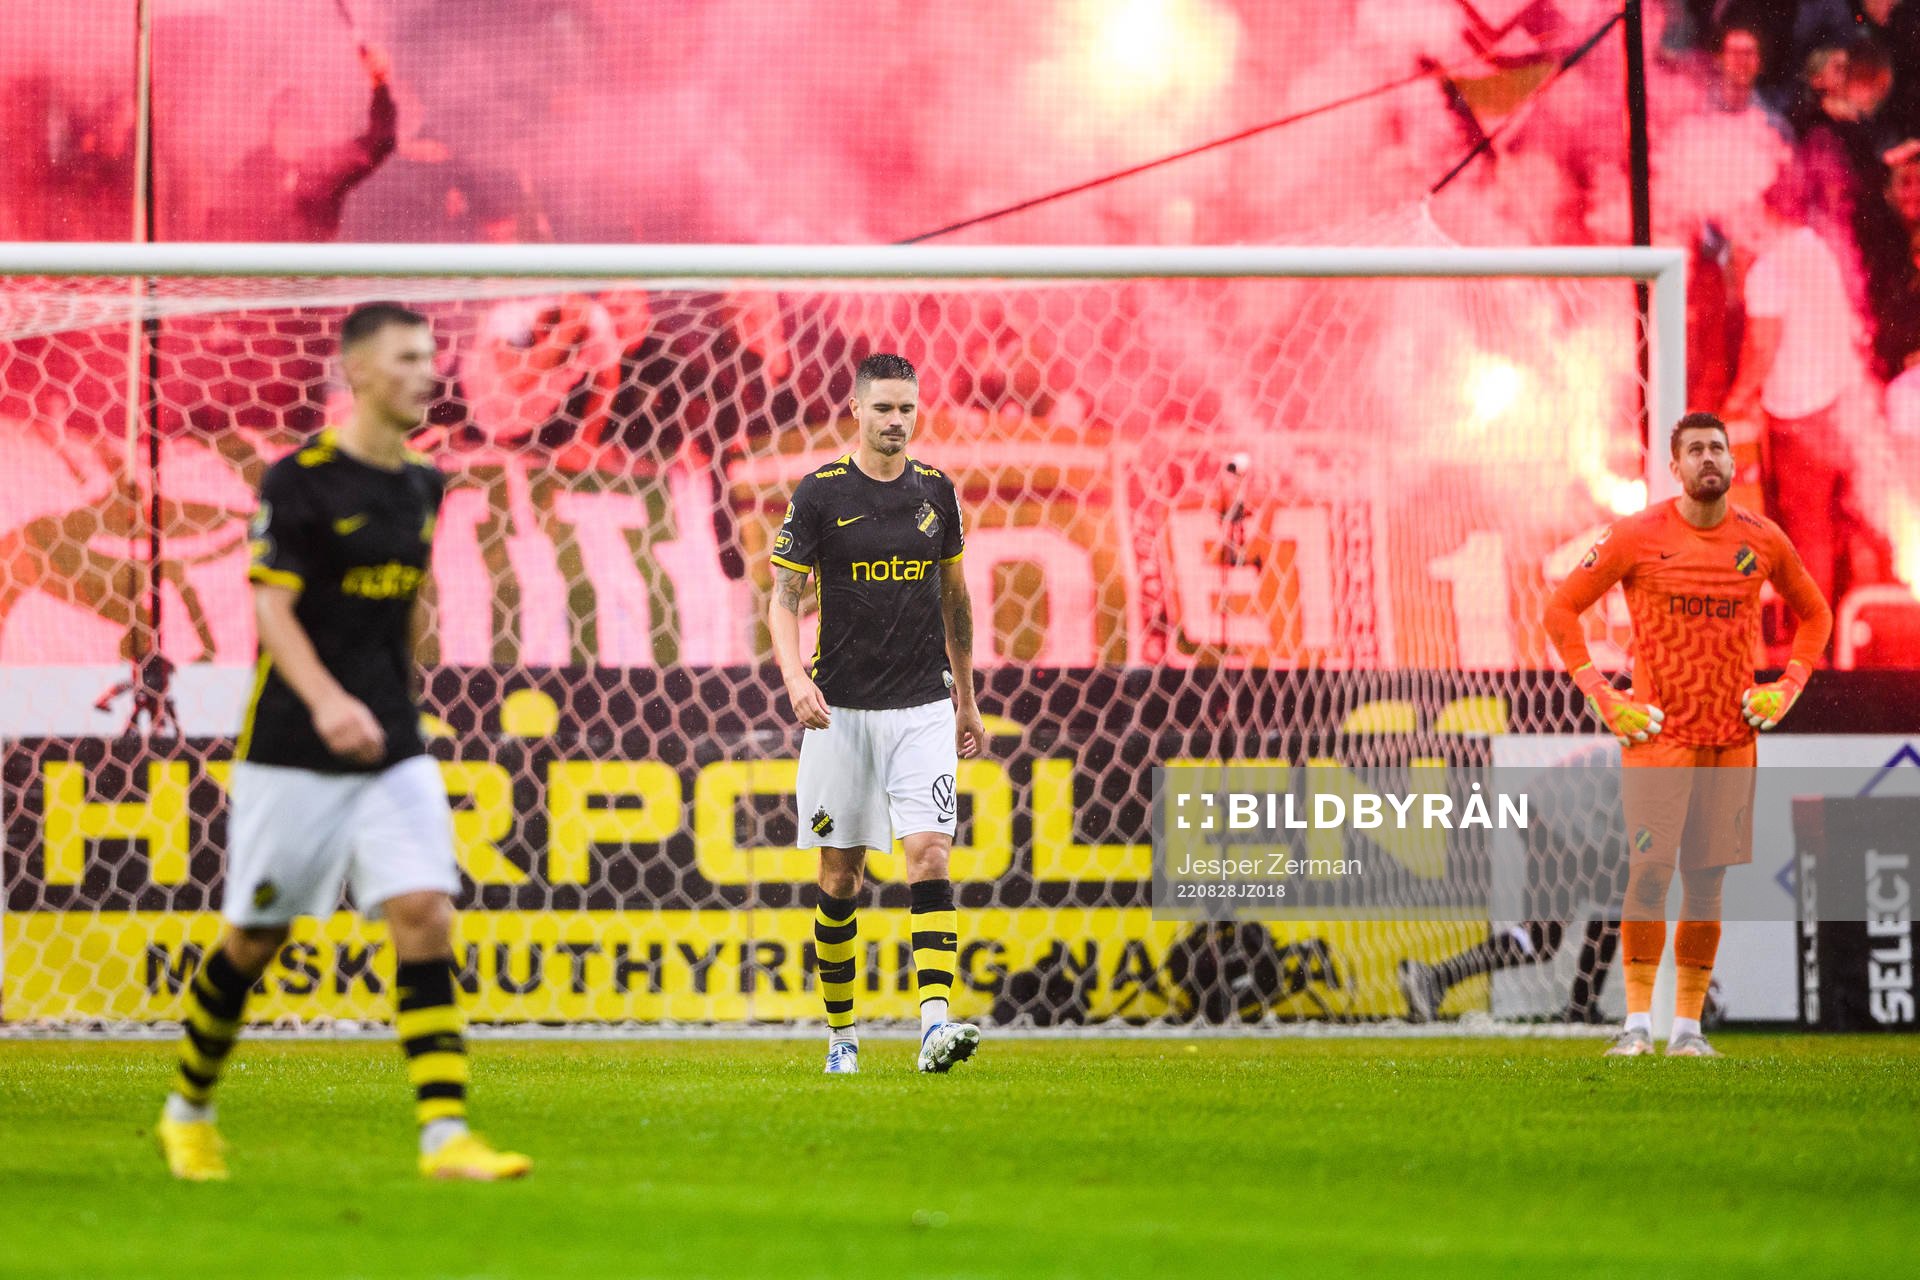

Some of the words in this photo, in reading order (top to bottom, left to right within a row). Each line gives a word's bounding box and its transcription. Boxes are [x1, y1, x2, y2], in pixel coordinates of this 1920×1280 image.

[852, 556, 932, 581] notar
[1669, 594, 1742, 619] notar
[43, 757, 1447, 887] HRPOOLEN
[1865, 849, 1914, 1025] SELECT
